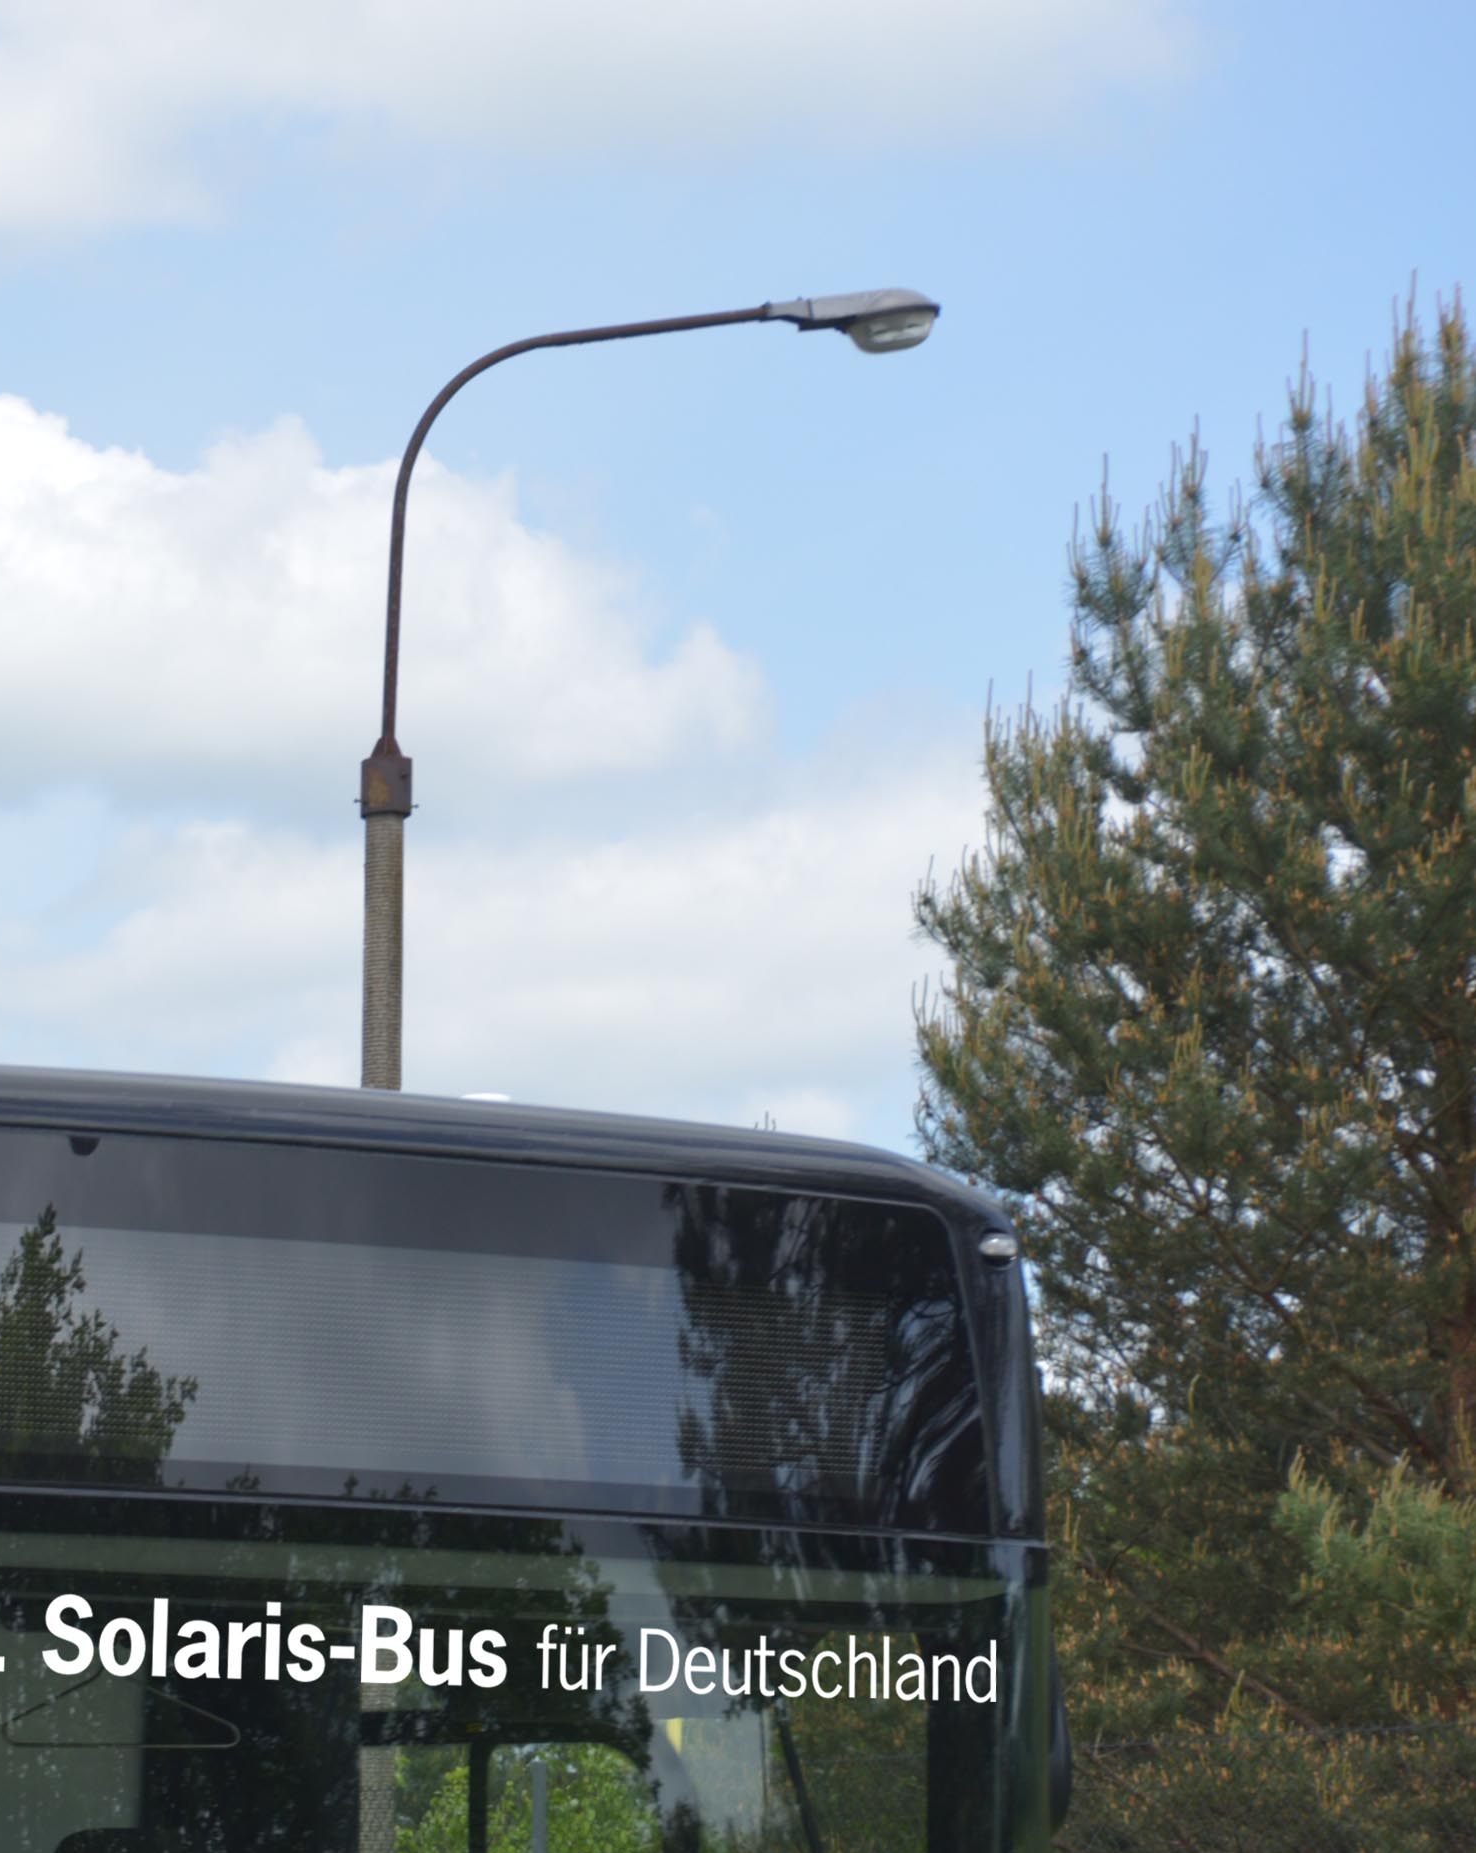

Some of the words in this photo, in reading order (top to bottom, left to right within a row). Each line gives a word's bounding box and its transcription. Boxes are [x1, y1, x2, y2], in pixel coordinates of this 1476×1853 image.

[42, 1594, 507, 1688] Solaris-Bus
[536, 1624, 616, 1691] für
[639, 1628, 997, 1703] Deutschland
